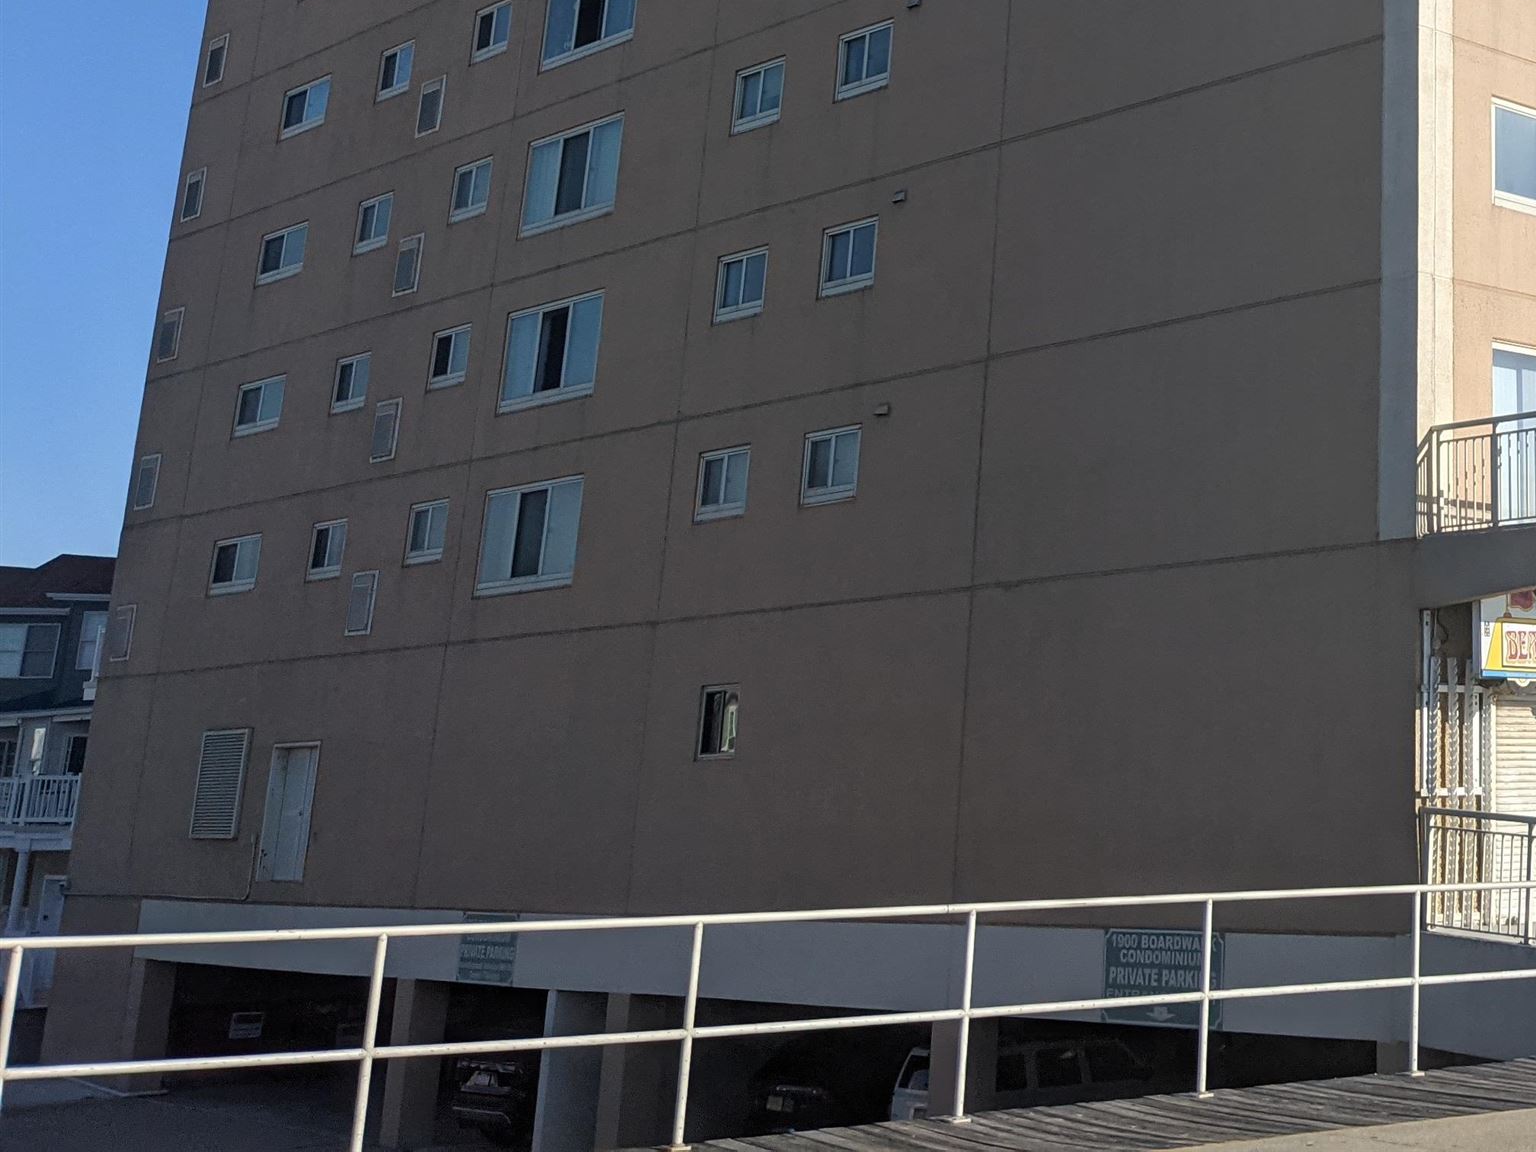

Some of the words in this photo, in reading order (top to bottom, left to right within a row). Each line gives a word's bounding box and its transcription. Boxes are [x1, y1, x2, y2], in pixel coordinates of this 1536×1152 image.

[1112, 934, 1138, 948] 1900
[1120, 949, 1202, 966] CONDOMINIU
[1108, 966, 1159, 986] PRIVATE
